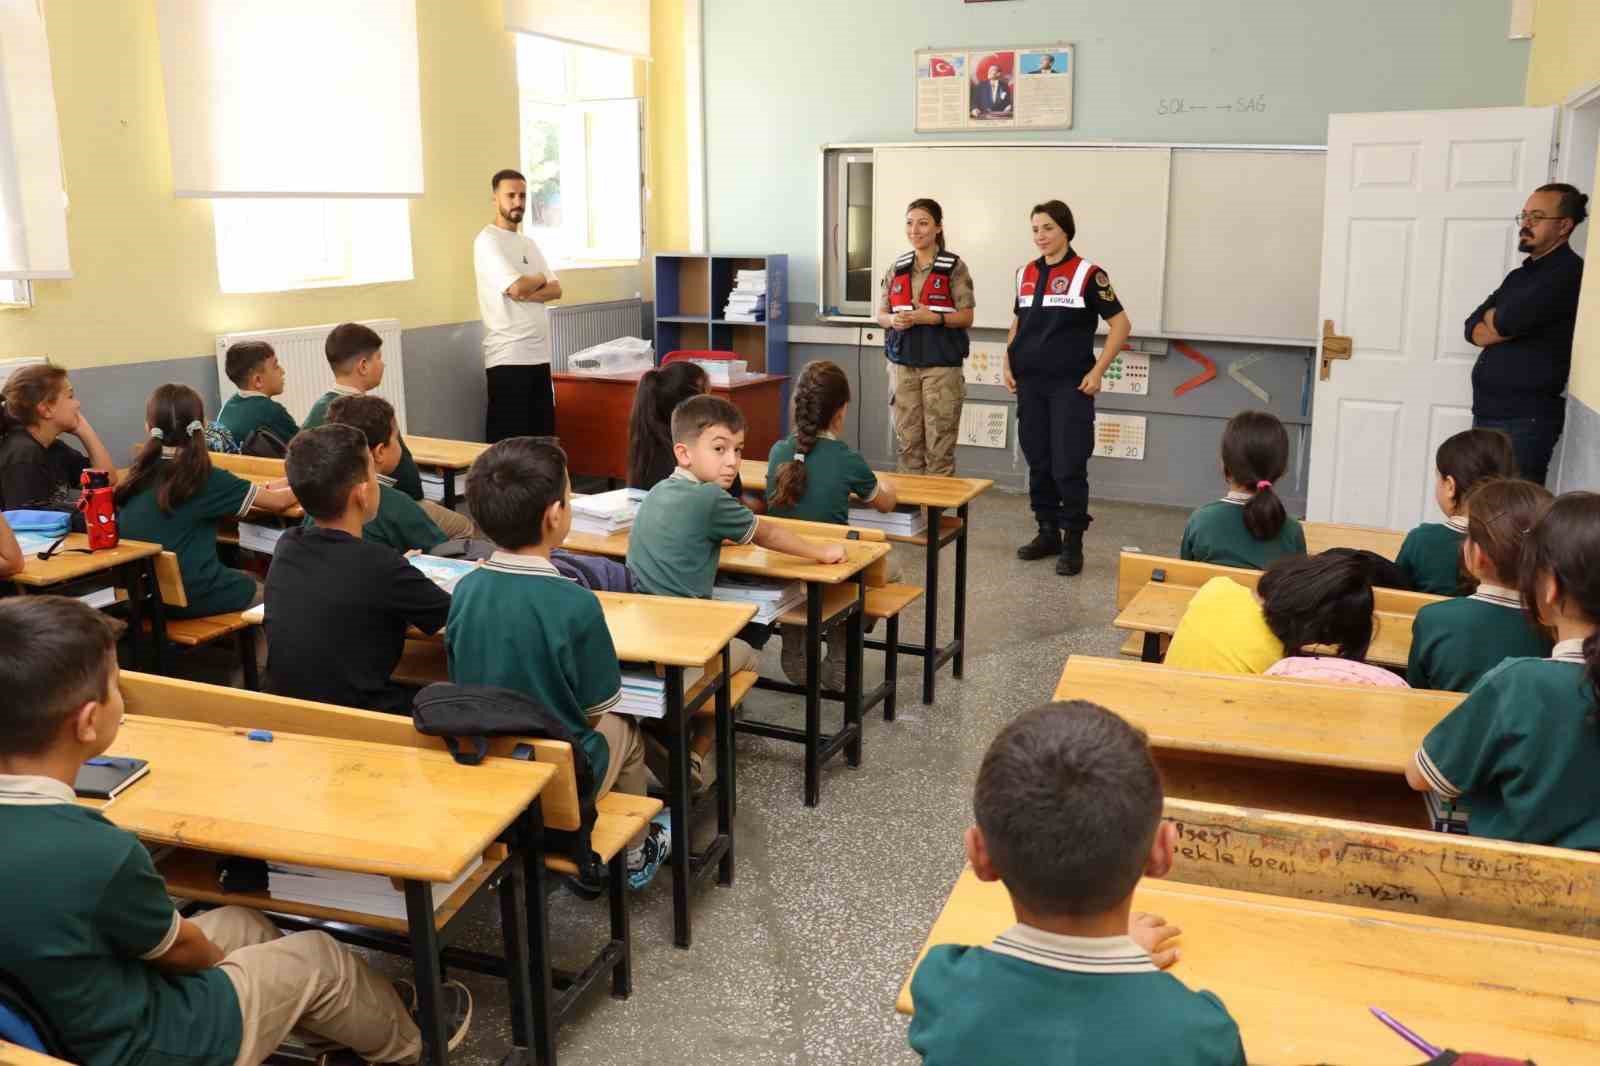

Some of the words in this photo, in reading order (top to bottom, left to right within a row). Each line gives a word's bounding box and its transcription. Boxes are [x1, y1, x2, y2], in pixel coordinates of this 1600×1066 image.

[1158, 97, 1191, 115] SOL
[1130, 382, 1141, 393] 10
[1126, 447, 1138, 457] 20
